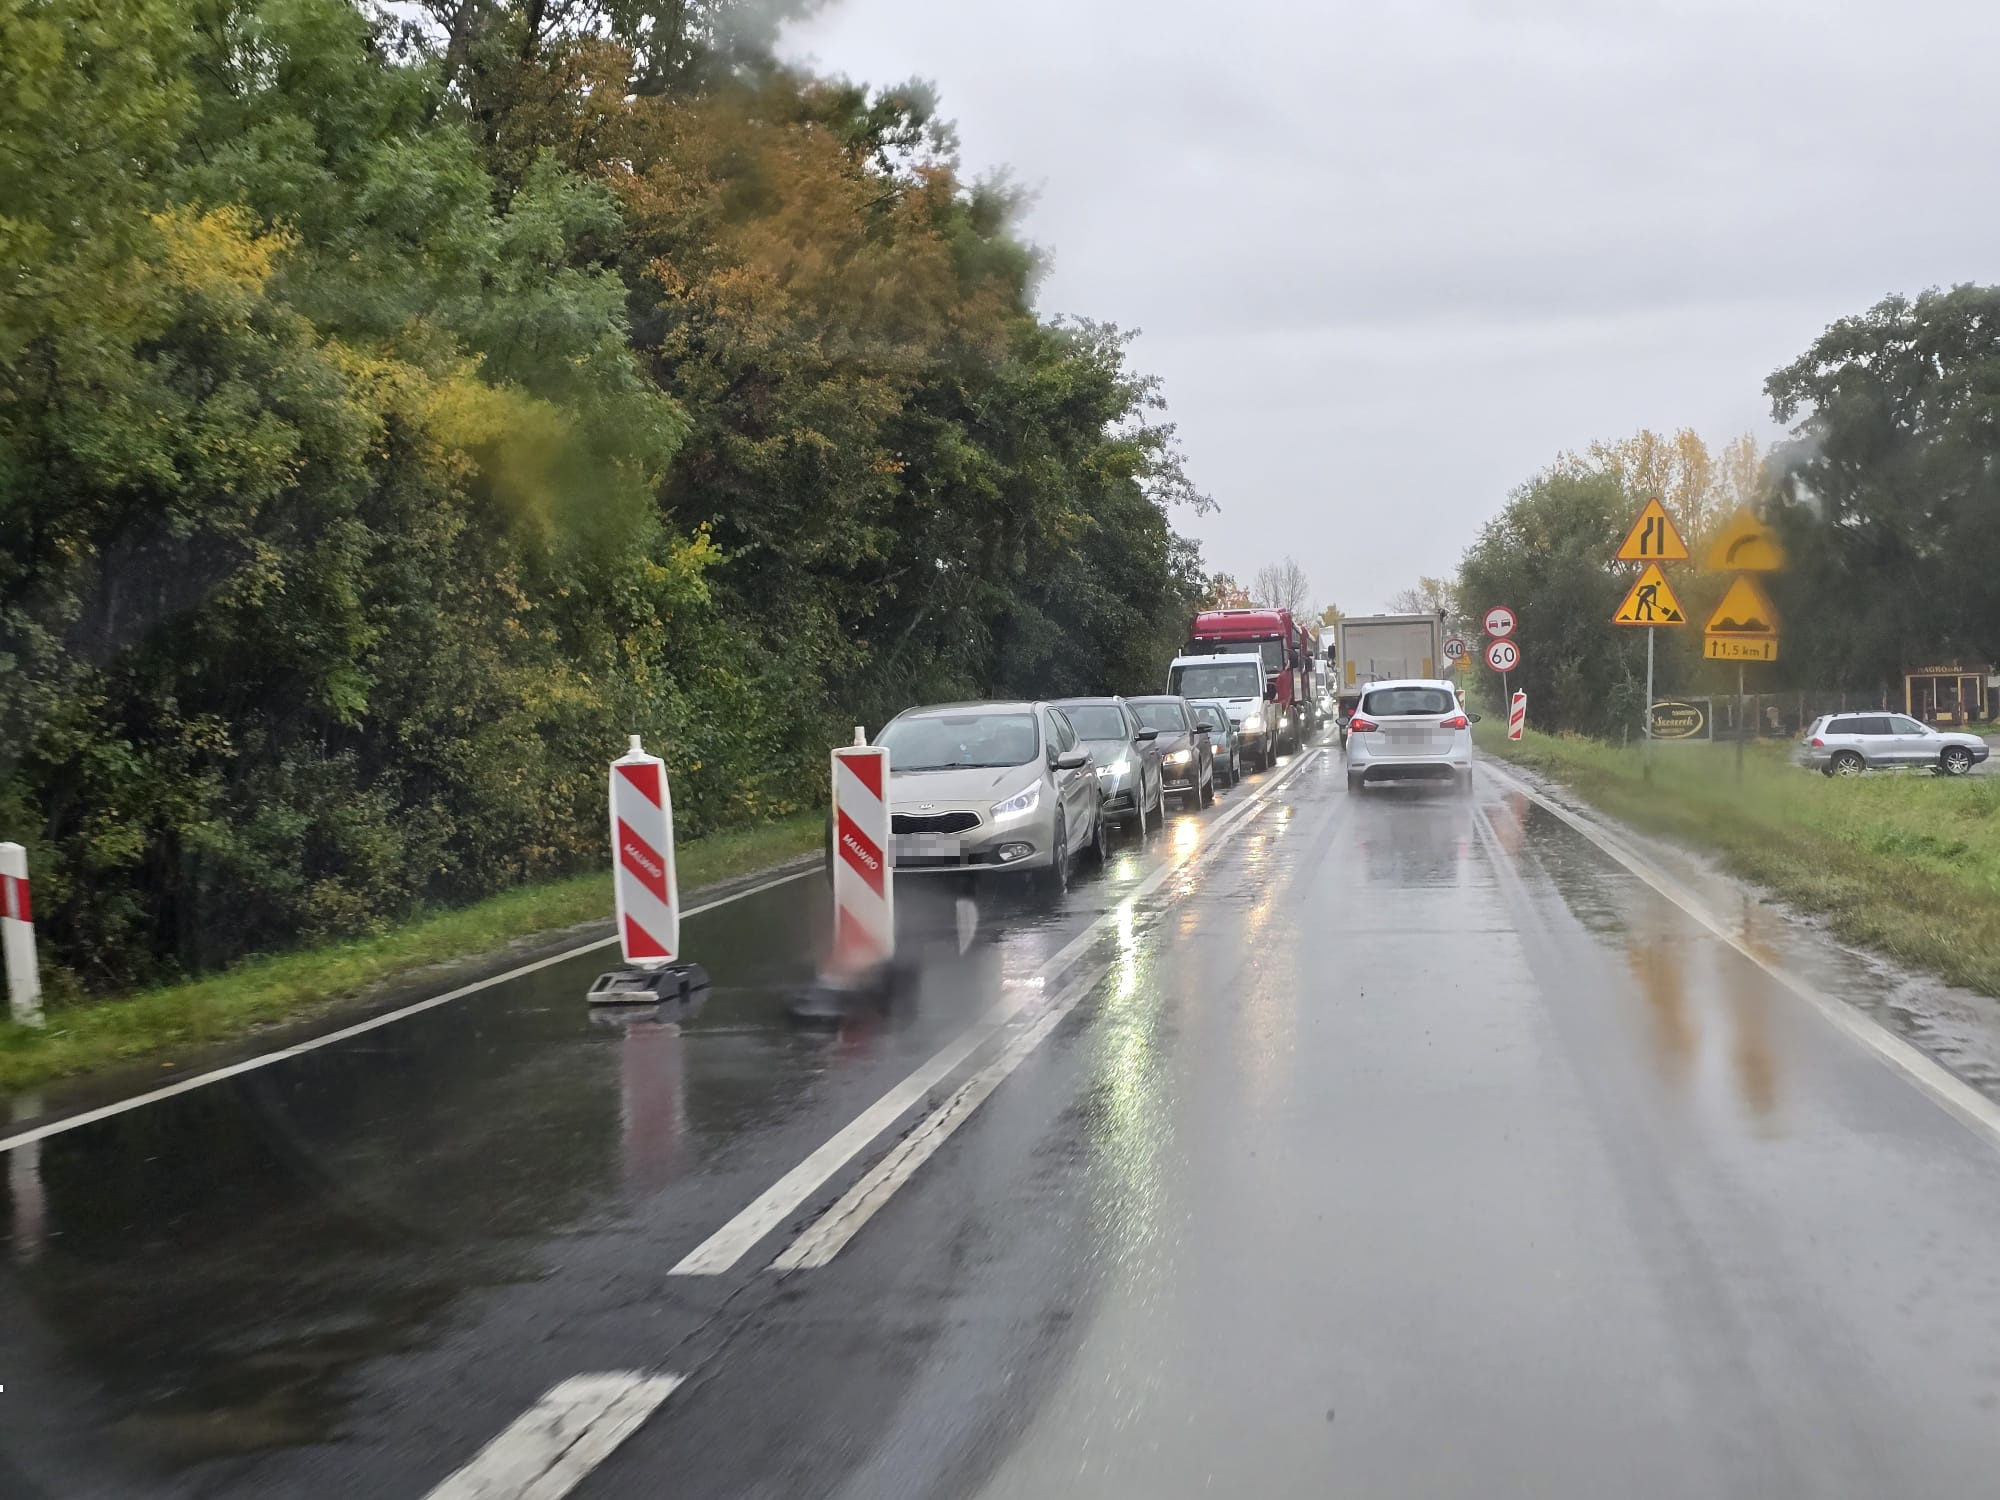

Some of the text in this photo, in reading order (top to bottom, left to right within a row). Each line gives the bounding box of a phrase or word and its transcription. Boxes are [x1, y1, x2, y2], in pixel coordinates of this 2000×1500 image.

[1446, 643, 1463, 655] 40
[1491, 647, 1515, 664] 60
[1743, 646, 1760, 657] km
[842, 833, 878, 870] MALWRO
[624, 843, 662, 878] MALWRO
